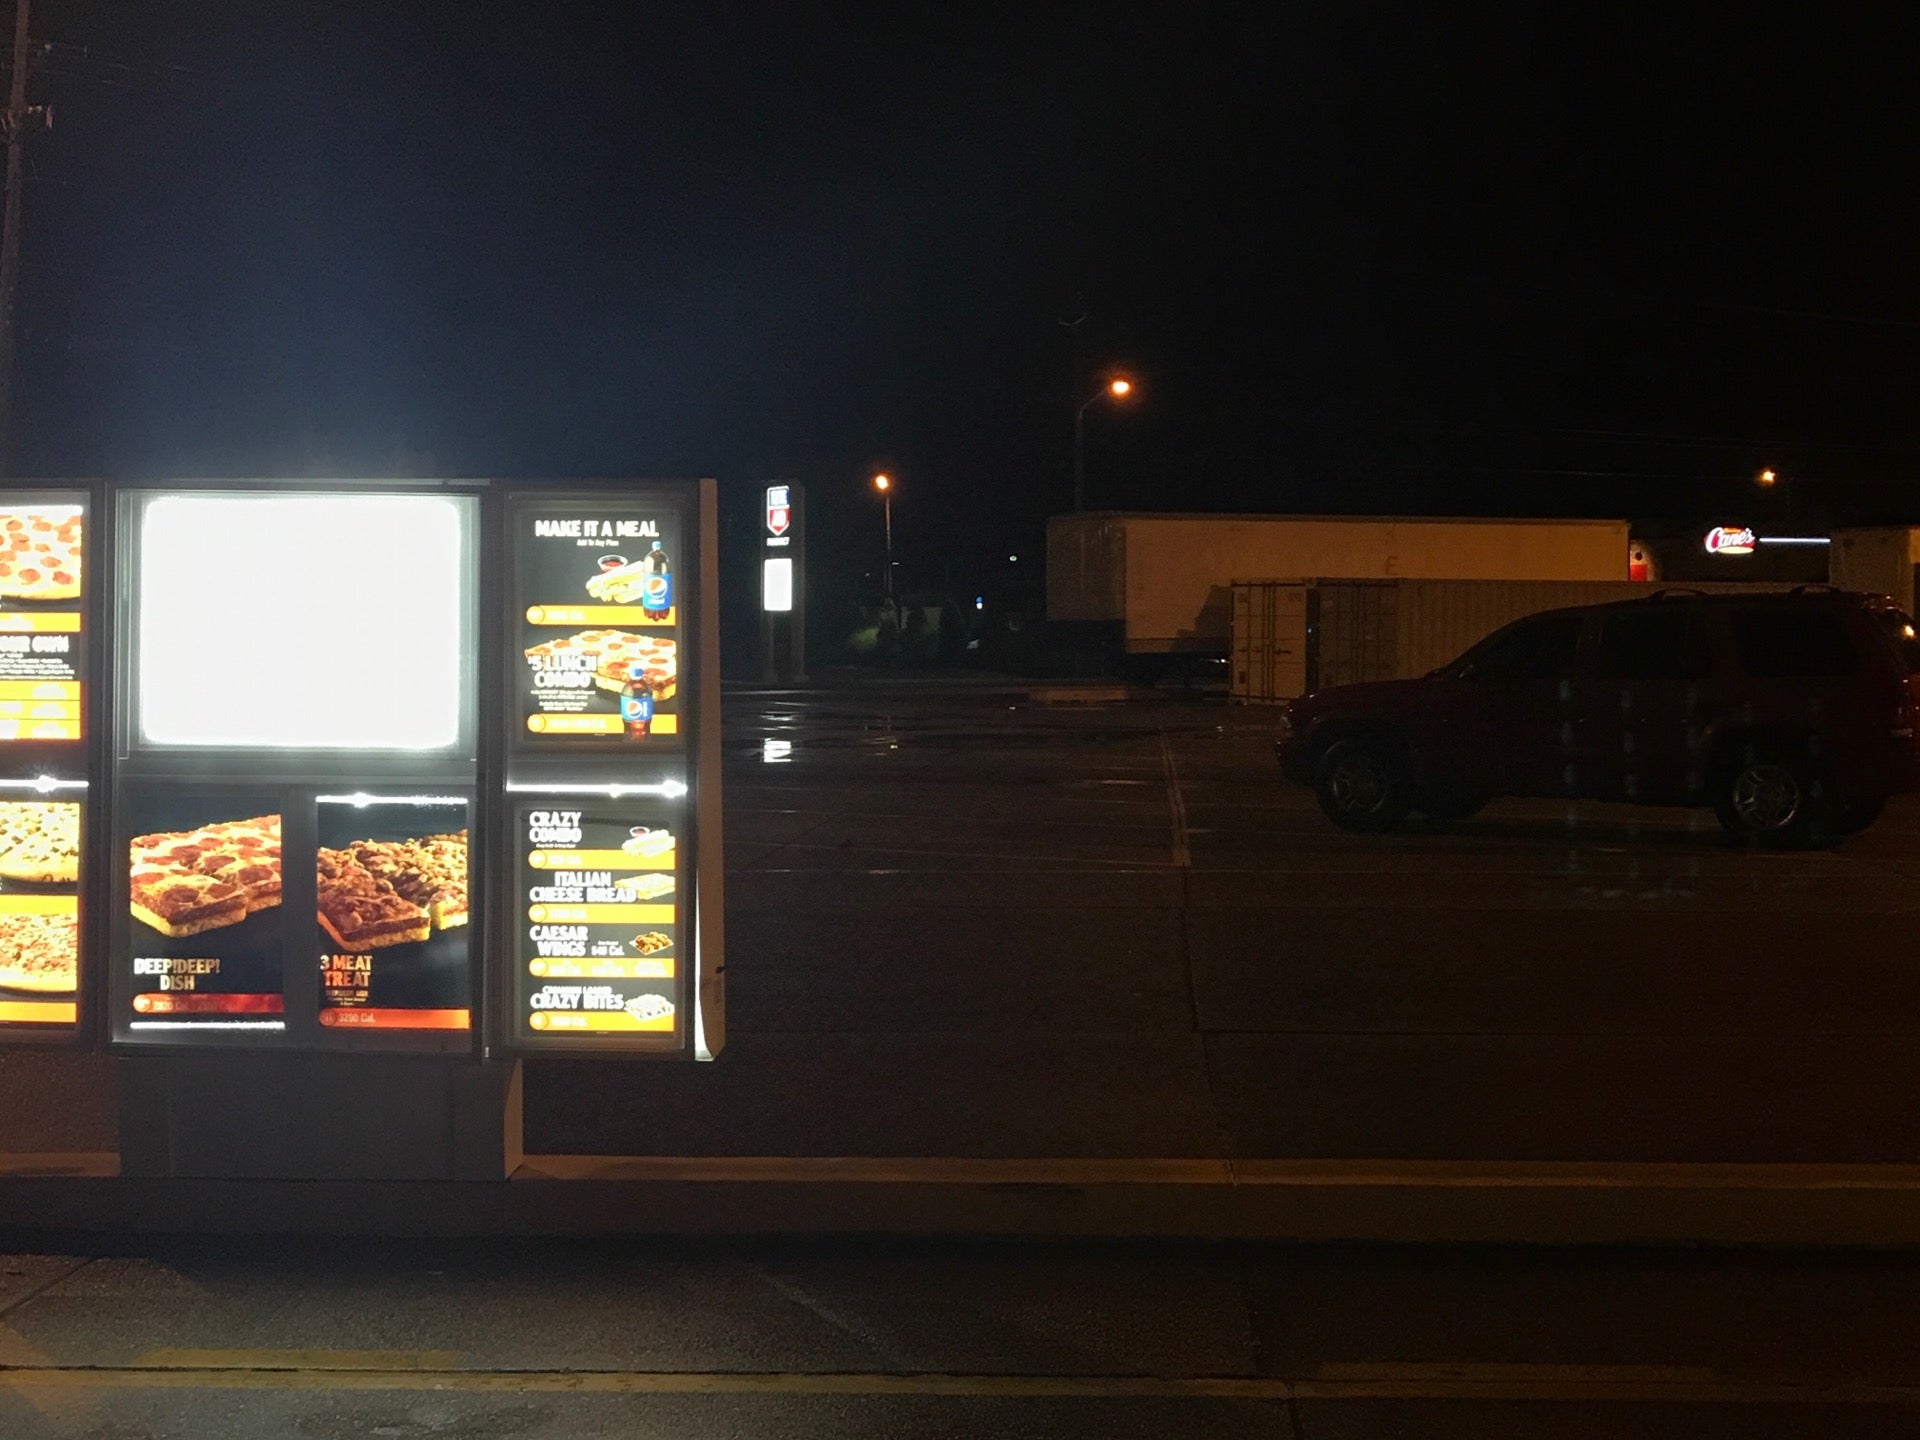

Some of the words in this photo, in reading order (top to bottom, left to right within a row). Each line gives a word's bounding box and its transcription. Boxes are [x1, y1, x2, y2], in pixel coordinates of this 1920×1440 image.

[535, 519, 581, 537] MAKE
[583, 520, 599, 537] IT
[601, 520, 613, 537] A
[616, 519, 660, 537] MEAL
[545, 654, 597, 671] LUNCH
[535, 671, 590, 687] COMBO
[530, 812, 581, 827] CRAZY
[530, 827, 582, 842] COMBO
[554, 871, 611, 887] ITALIAN
[529, 887, 584, 902] CHEESE
[586, 887, 637, 903] BREAD
[530, 925, 588, 941] CAESAR
[537, 941, 586, 956] WINGS
[320, 954, 330, 970] 3
[332, 955, 373, 970] MEAT
[160, 974, 196, 990] DISH
[323, 971, 371, 986] TREAT
[530, 993, 581, 1009] CRAZY
[583, 994, 625, 1009] BITES
